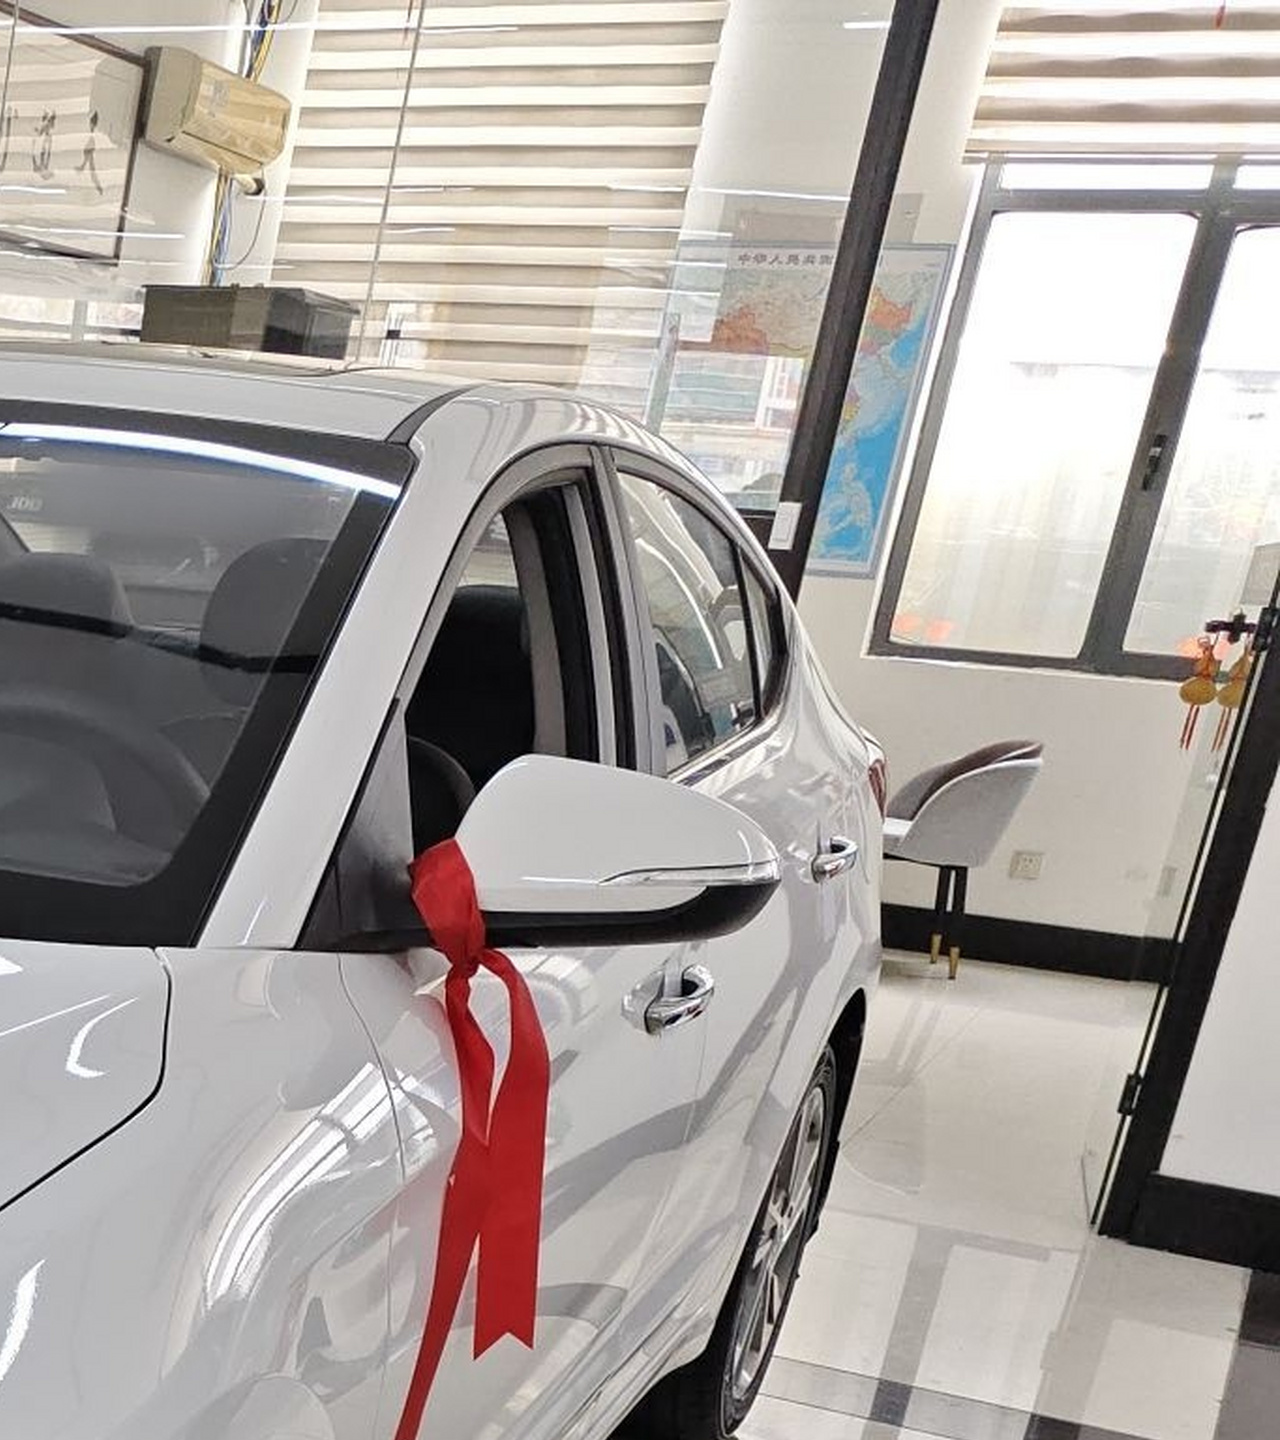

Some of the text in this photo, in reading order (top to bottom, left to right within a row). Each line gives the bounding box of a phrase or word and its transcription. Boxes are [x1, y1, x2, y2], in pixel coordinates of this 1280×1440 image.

[738, 252, 884, 267] 中华人民共和
